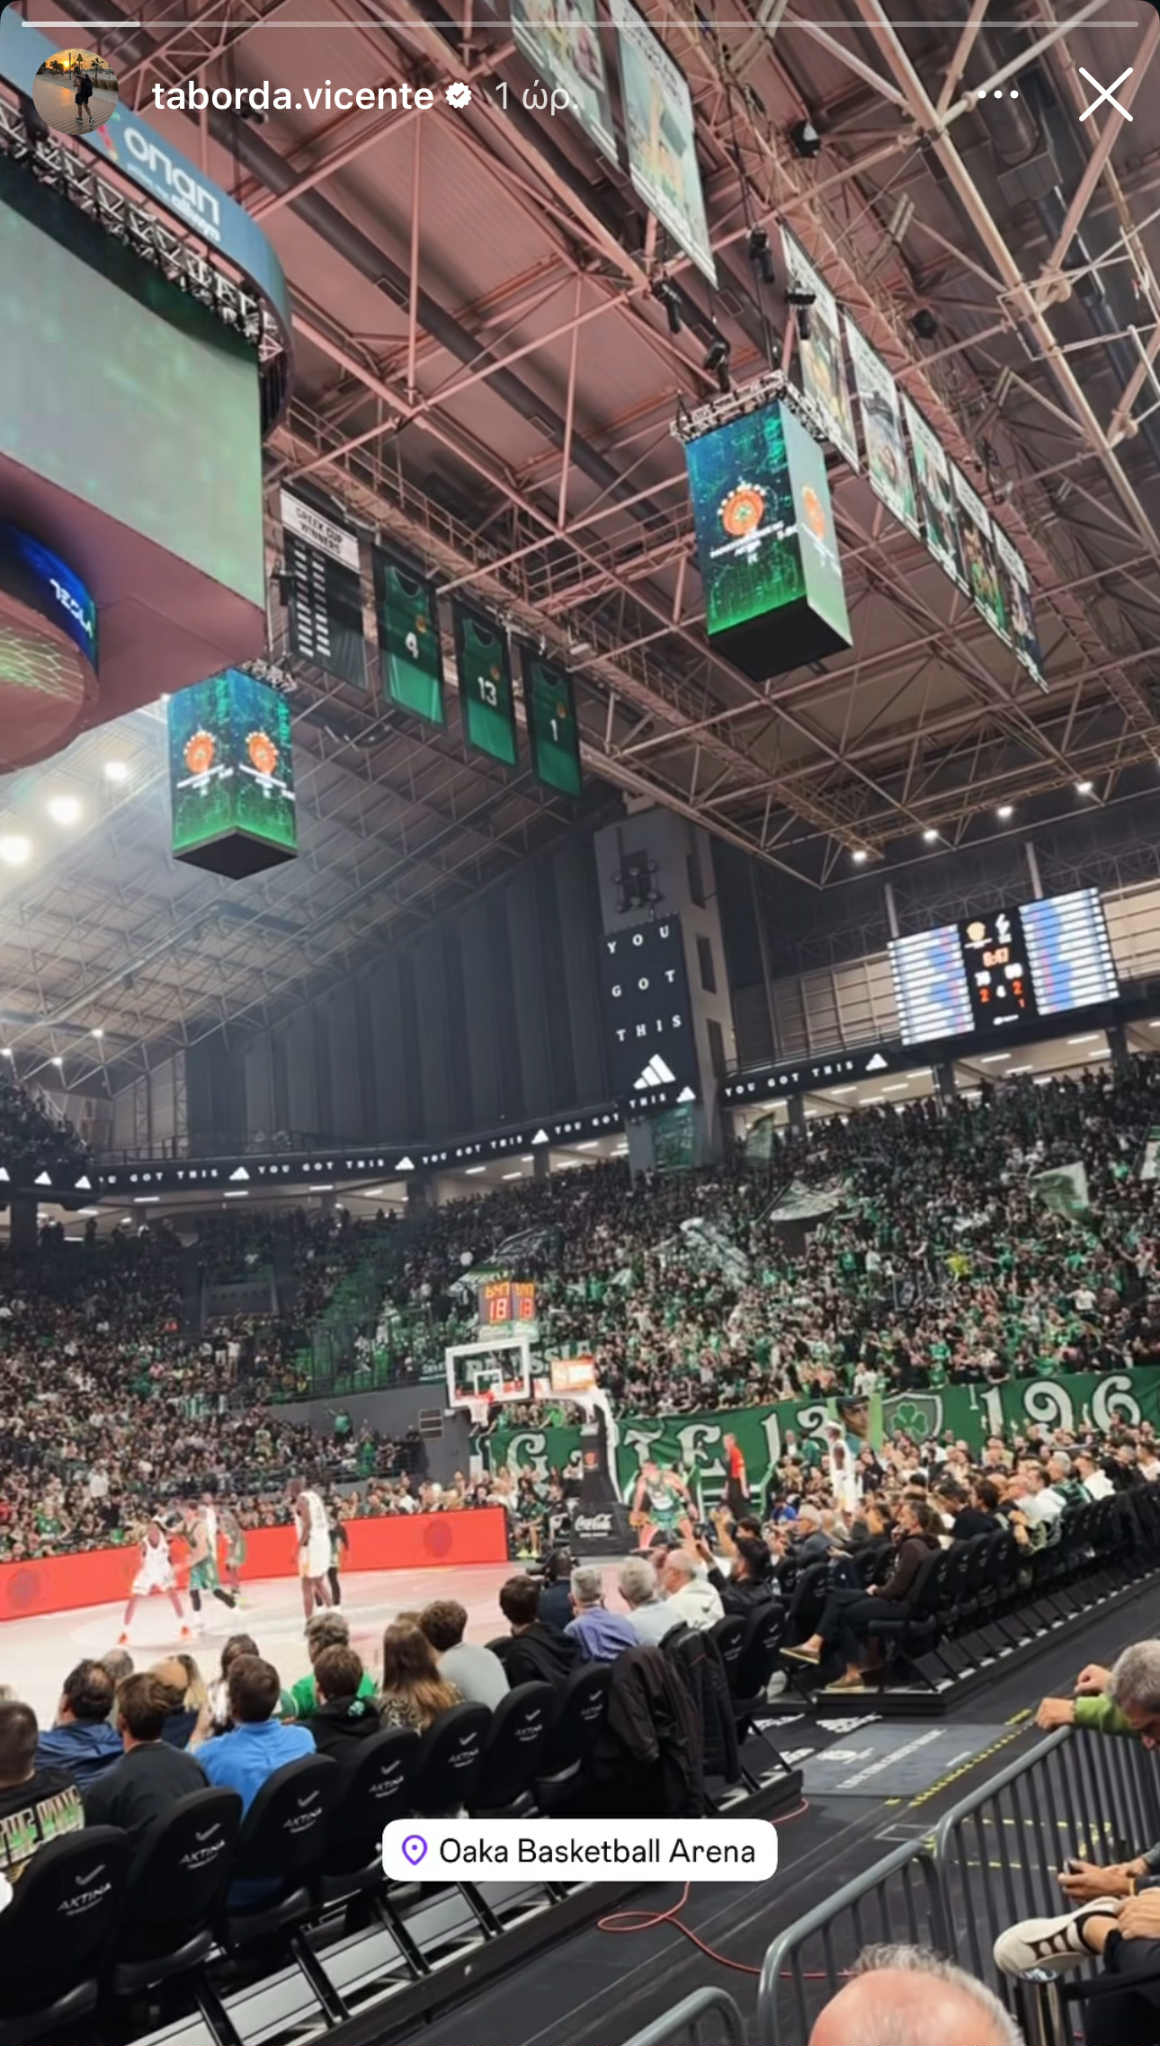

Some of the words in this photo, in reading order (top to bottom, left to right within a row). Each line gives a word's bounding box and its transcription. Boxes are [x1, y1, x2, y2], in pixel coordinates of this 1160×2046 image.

[477, 675, 498, 707] 13
[551, 719, 559, 742] 1
[607, 925, 670, 955] YOU
[611, 969, 676, 998] GOT
[616, 1014, 683, 1042] THIS
[725, 1082, 756, 1097] YOU
[767, 1072, 799, 1088] GOT
[812, 1060, 853, 1078] THIS
[554, 1122, 582, 1135] YOU
[592, 1113, 619, 1127] GOT
[629, 1093, 666, 1109] THIS
[422, 1152, 448, 1165] YOU
[456, 1144, 481, 1157] GOT
[490, 1135, 523, 1150] THIS
[129, 1172, 163, 1183] GOT
[176, 1168, 219, 1180] THIS
[257, 1164, 291, 1175] YOU
[302, 1160, 334, 1172] GOT
[345, 1157, 385, 1169] THIS
[489, 1297, 508, 1320] 18
